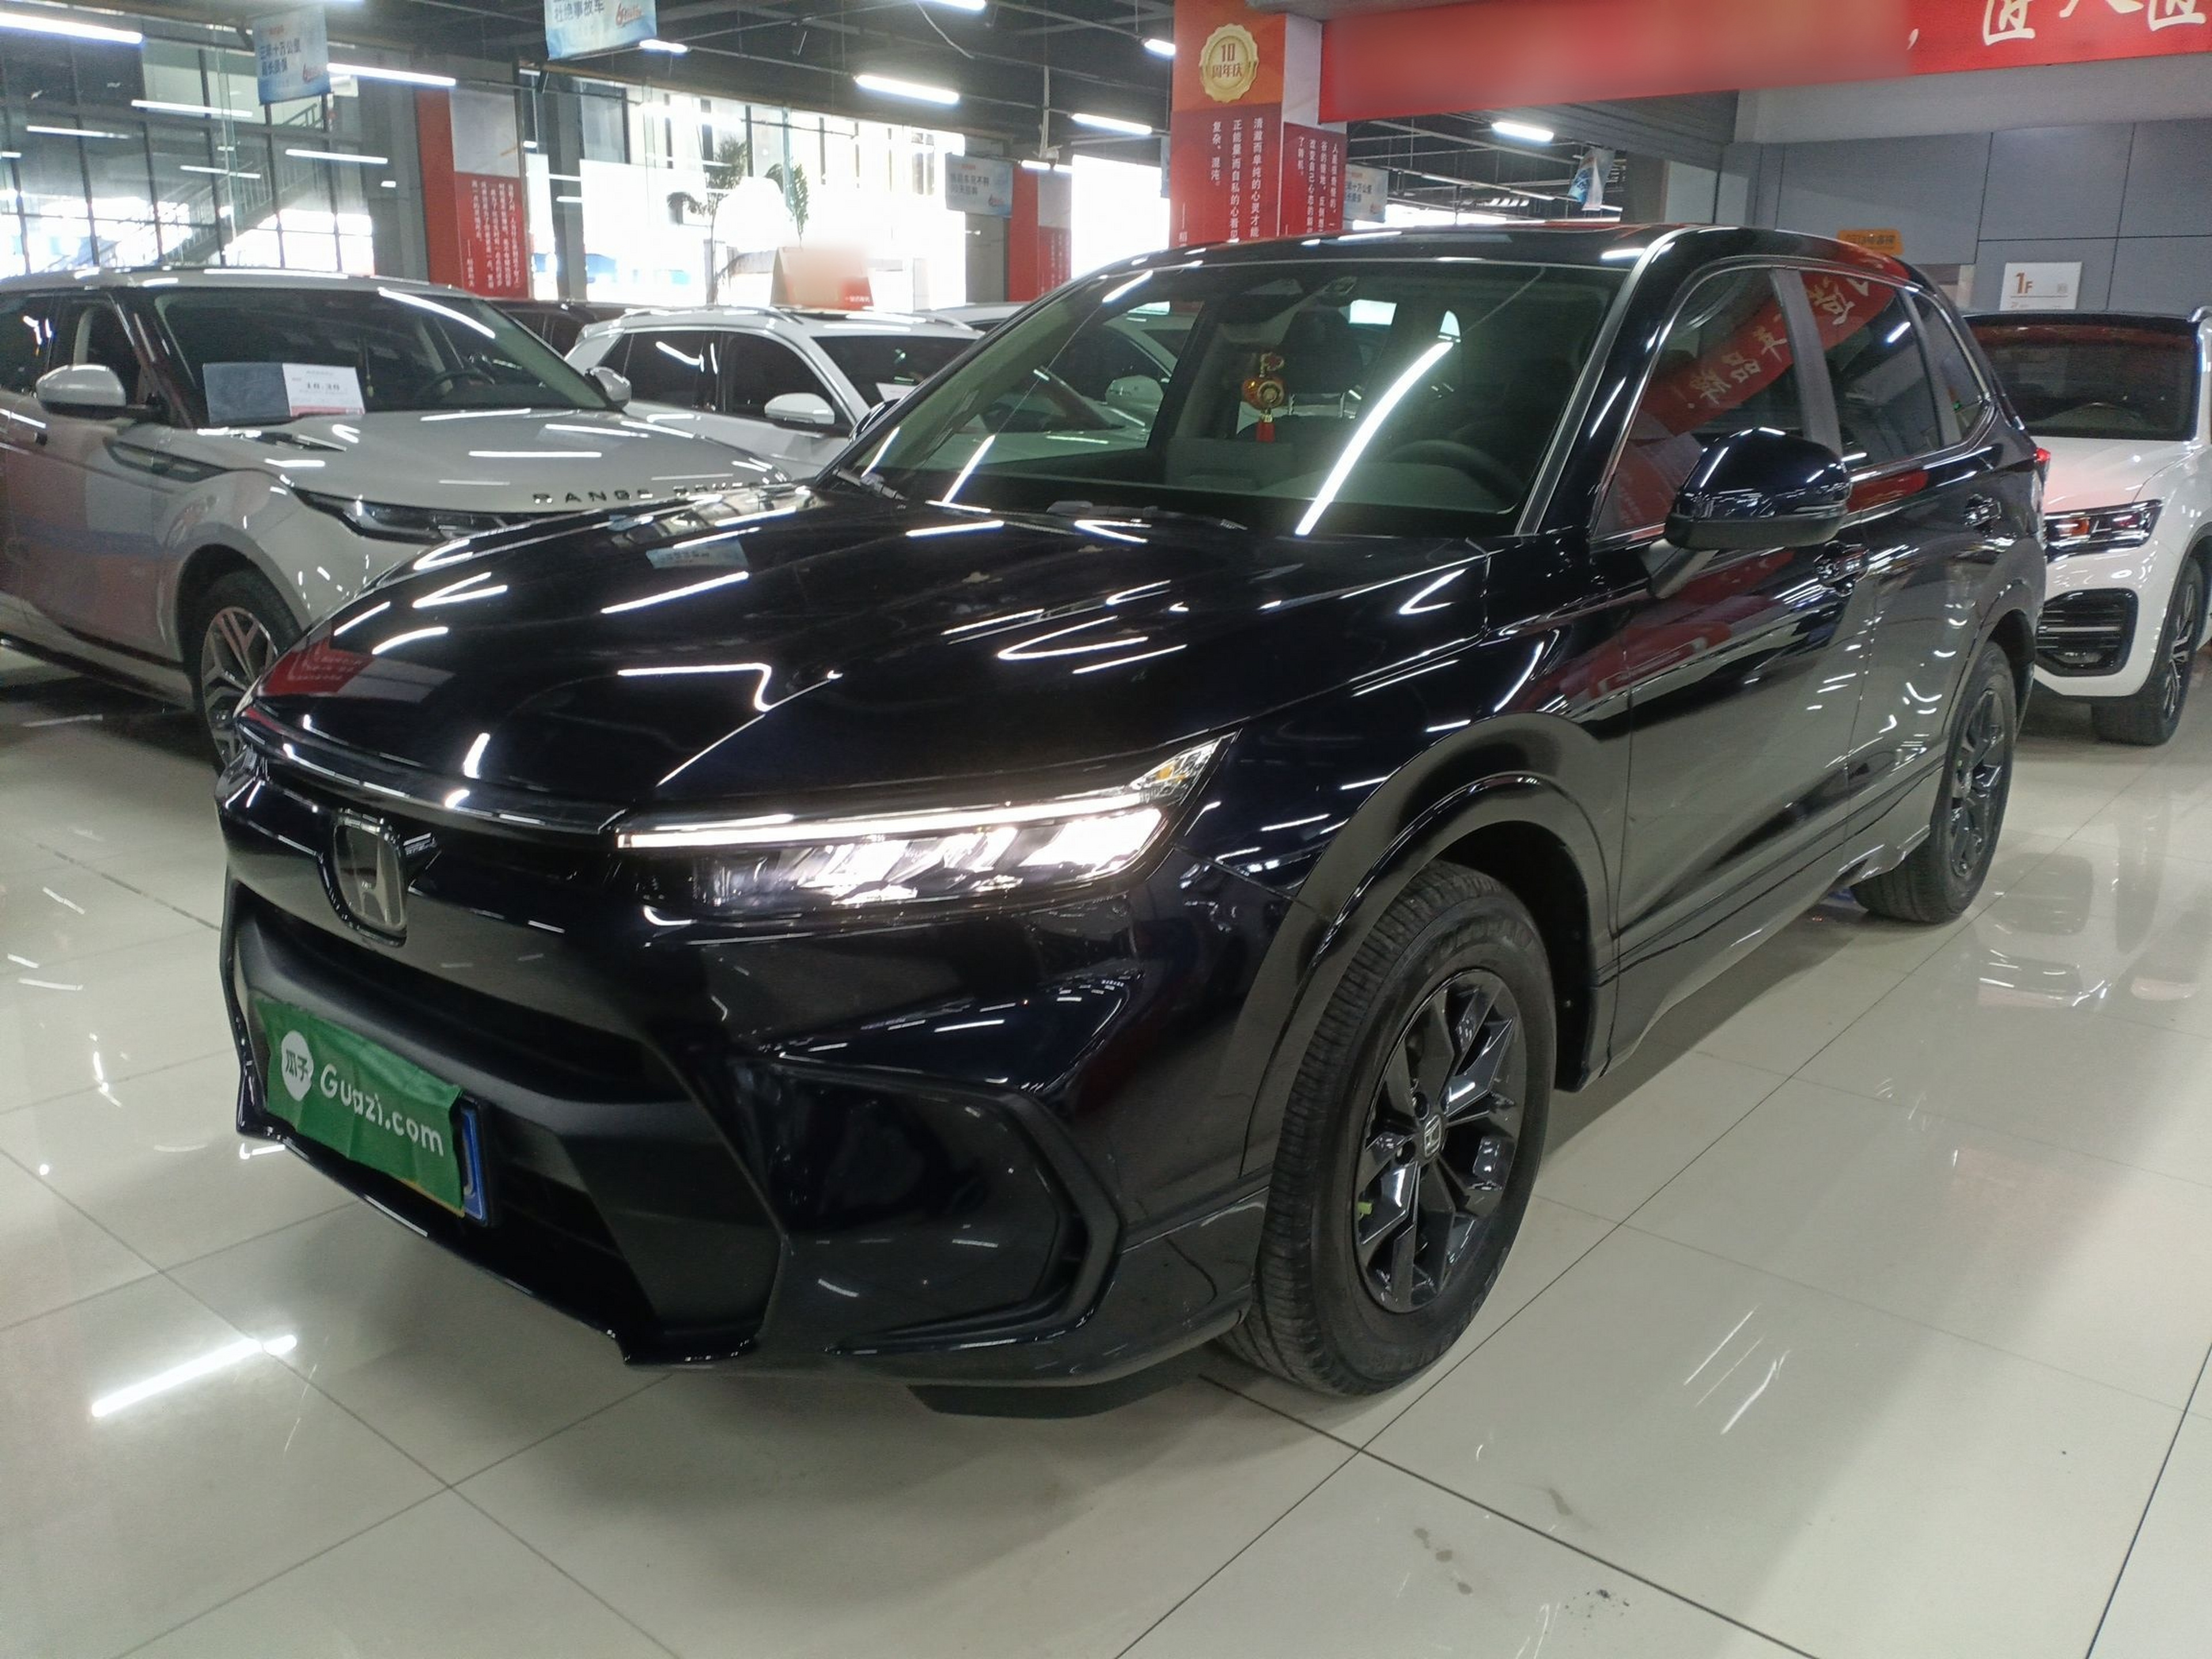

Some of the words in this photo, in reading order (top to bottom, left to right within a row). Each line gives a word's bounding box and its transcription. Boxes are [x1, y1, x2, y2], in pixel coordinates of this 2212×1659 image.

[1221, 44, 1236, 62] 10
[1213, 63, 1243, 78] 周年庆
[2016, 272, 2033, 294] 1F
[285, 1049, 309, 1082] 瓜子
[320, 1063, 444, 1157] Guazi.com
